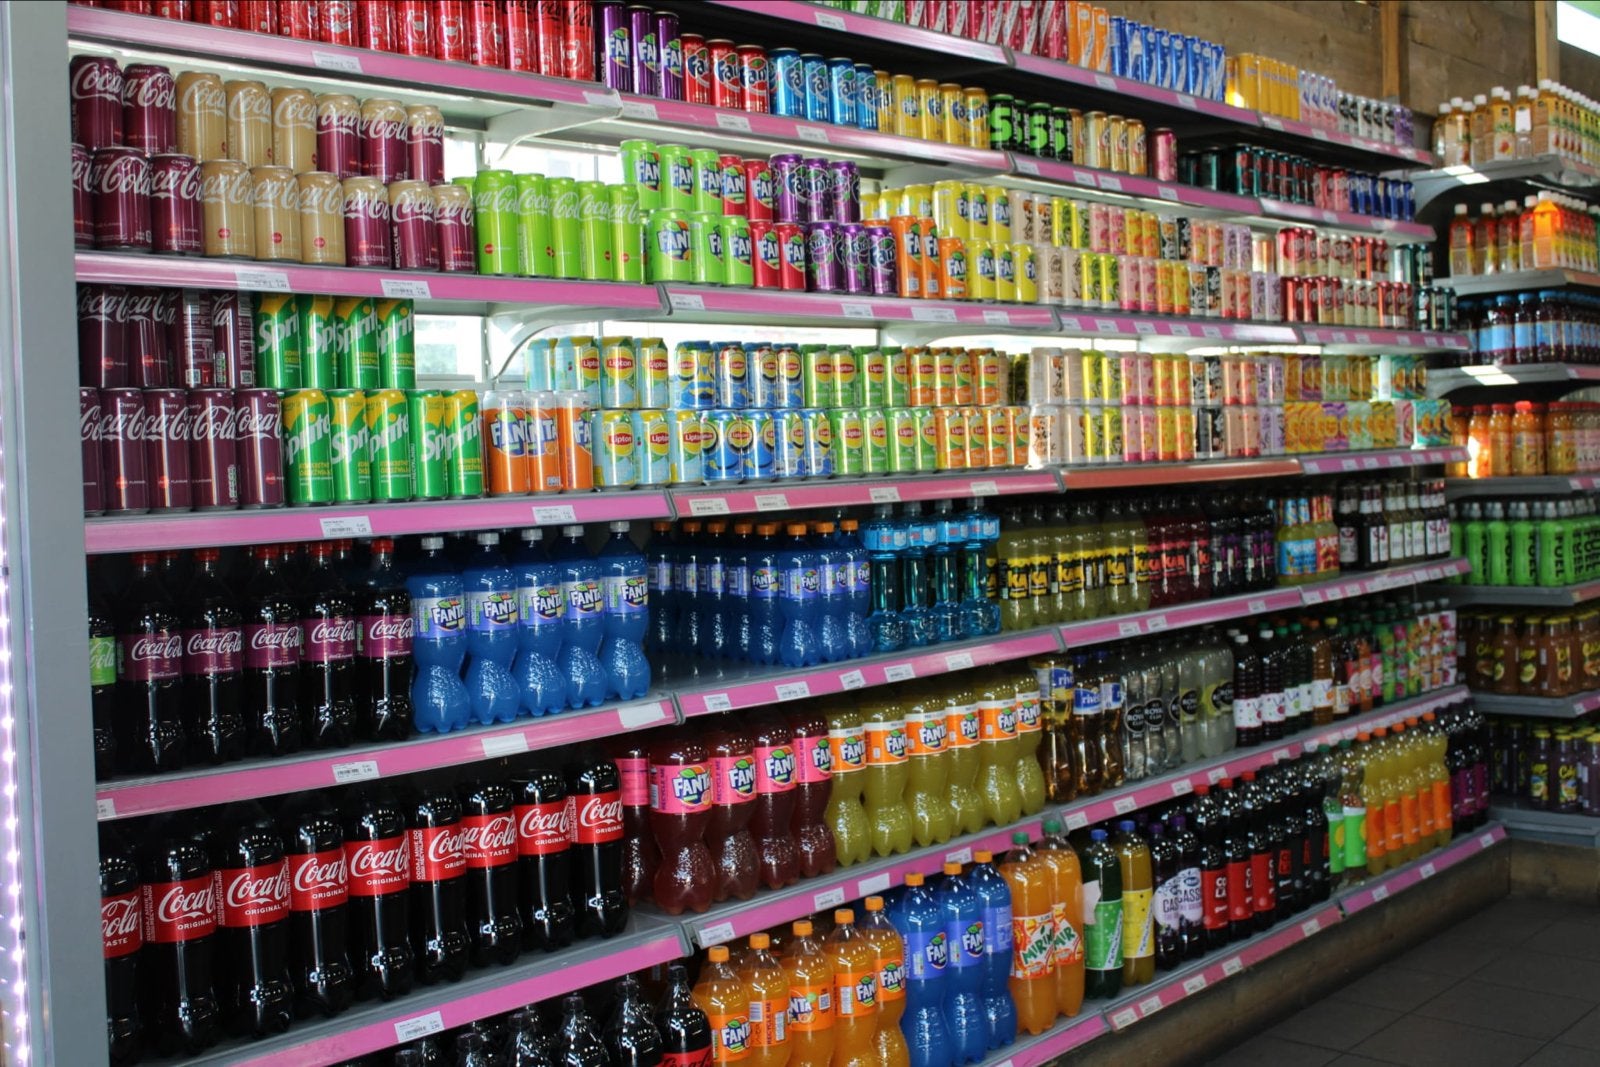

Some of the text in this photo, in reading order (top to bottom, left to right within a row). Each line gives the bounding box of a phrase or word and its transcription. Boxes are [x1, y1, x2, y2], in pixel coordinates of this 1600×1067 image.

[534, 836, 565, 847] ORIGINAL
[488, 848, 511, 858] TASTE
[366, 875, 402, 887] ORIGINAL
[312, 887, 345, 900] ORIGINAL
[245, 904, 282, 916] ORIGINAL
[177, 918, 212, 931] ORIGINAL
